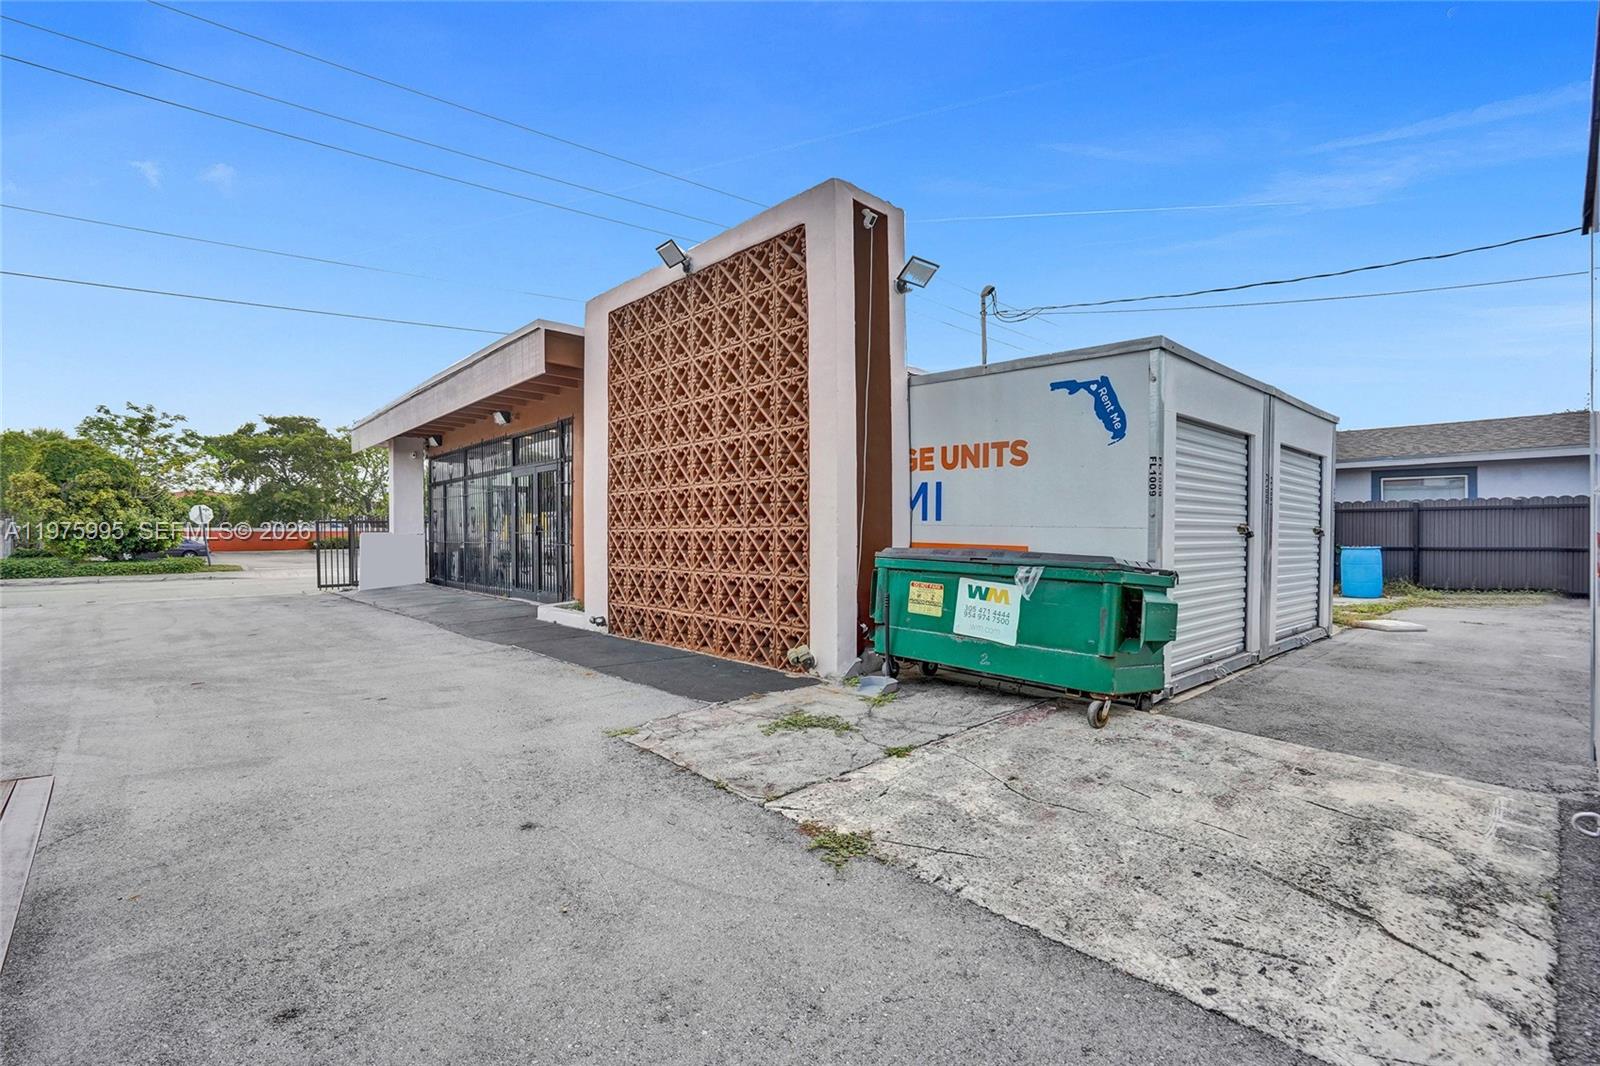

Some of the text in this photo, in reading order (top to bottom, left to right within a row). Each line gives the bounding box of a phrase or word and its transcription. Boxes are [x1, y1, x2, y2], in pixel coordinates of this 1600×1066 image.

[1098, 386, 1122, 430] Rent Me
[941, 439, 1029, 470] UNITS
[1149, 456, 1157, 497] FL1009
[967, 584, 1010, 605] WM
[963, 610, 1010, 626] 954 974 7500
[978, 607, 991, 615] 471
[993, 609, 1010, 619] 4444
[979, 652, 991, 666] 2
